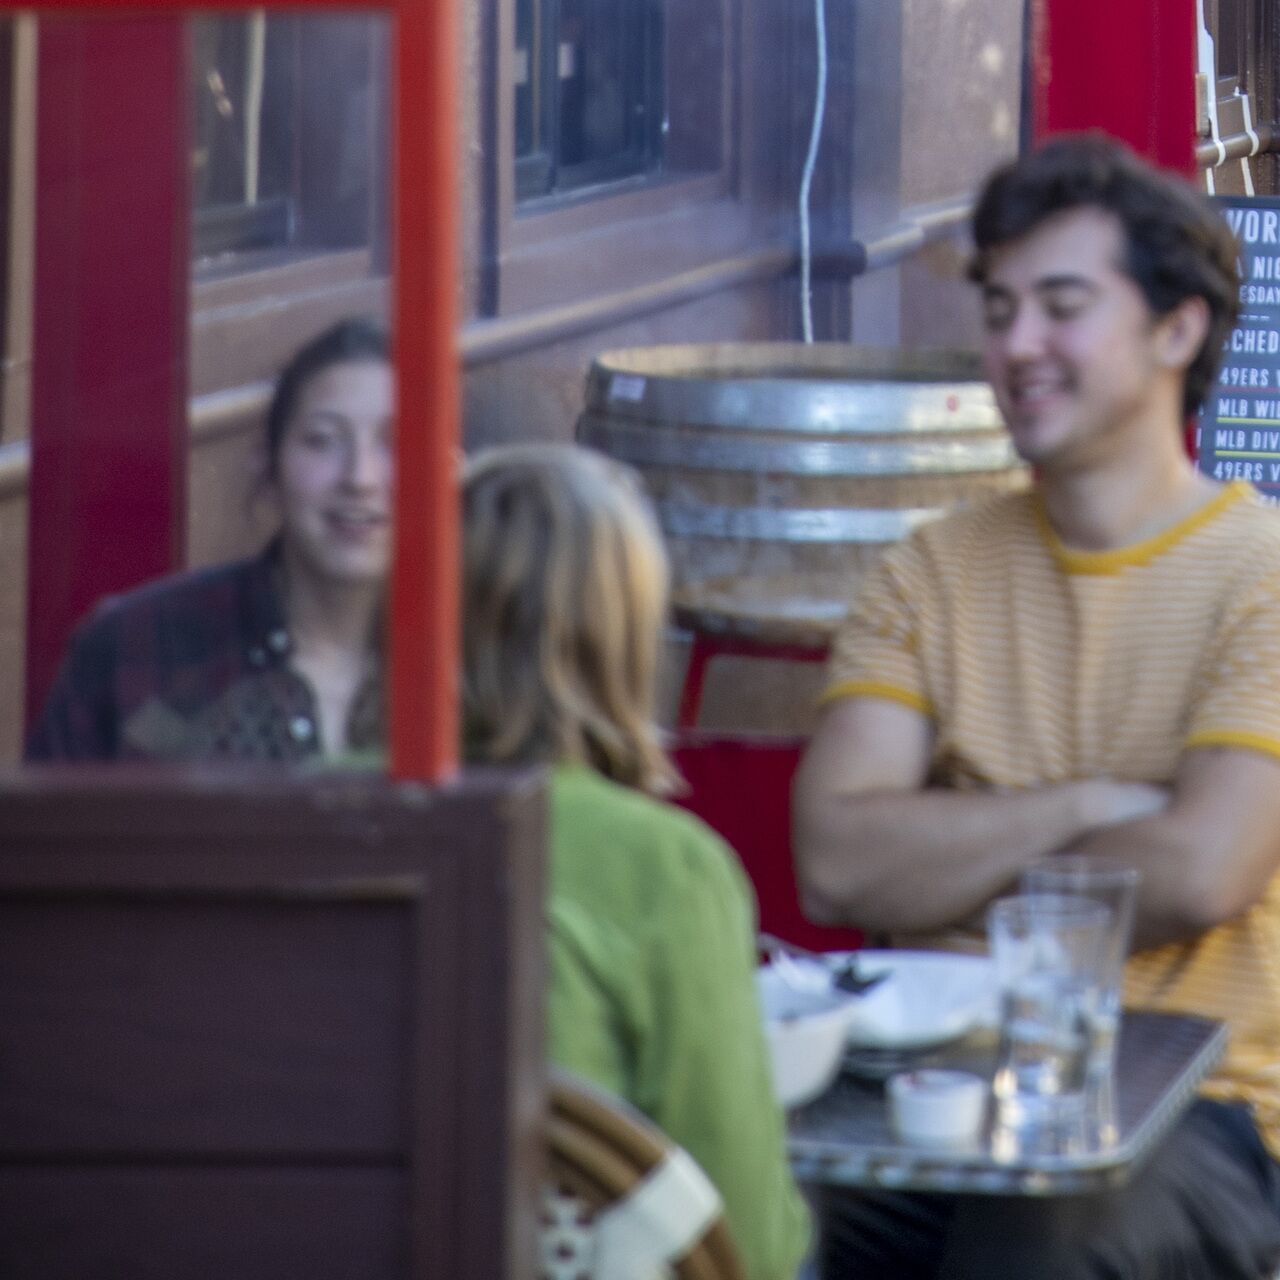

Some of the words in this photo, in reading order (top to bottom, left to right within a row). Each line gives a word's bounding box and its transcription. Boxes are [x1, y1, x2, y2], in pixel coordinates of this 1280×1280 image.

[1219, 366, 1270, 388] 49ERS
[1218, 397, 1248, 418] MLB
[1215, 428, 1246, 450] MLB
[1213, 460, 1264, 482] 49ERS
